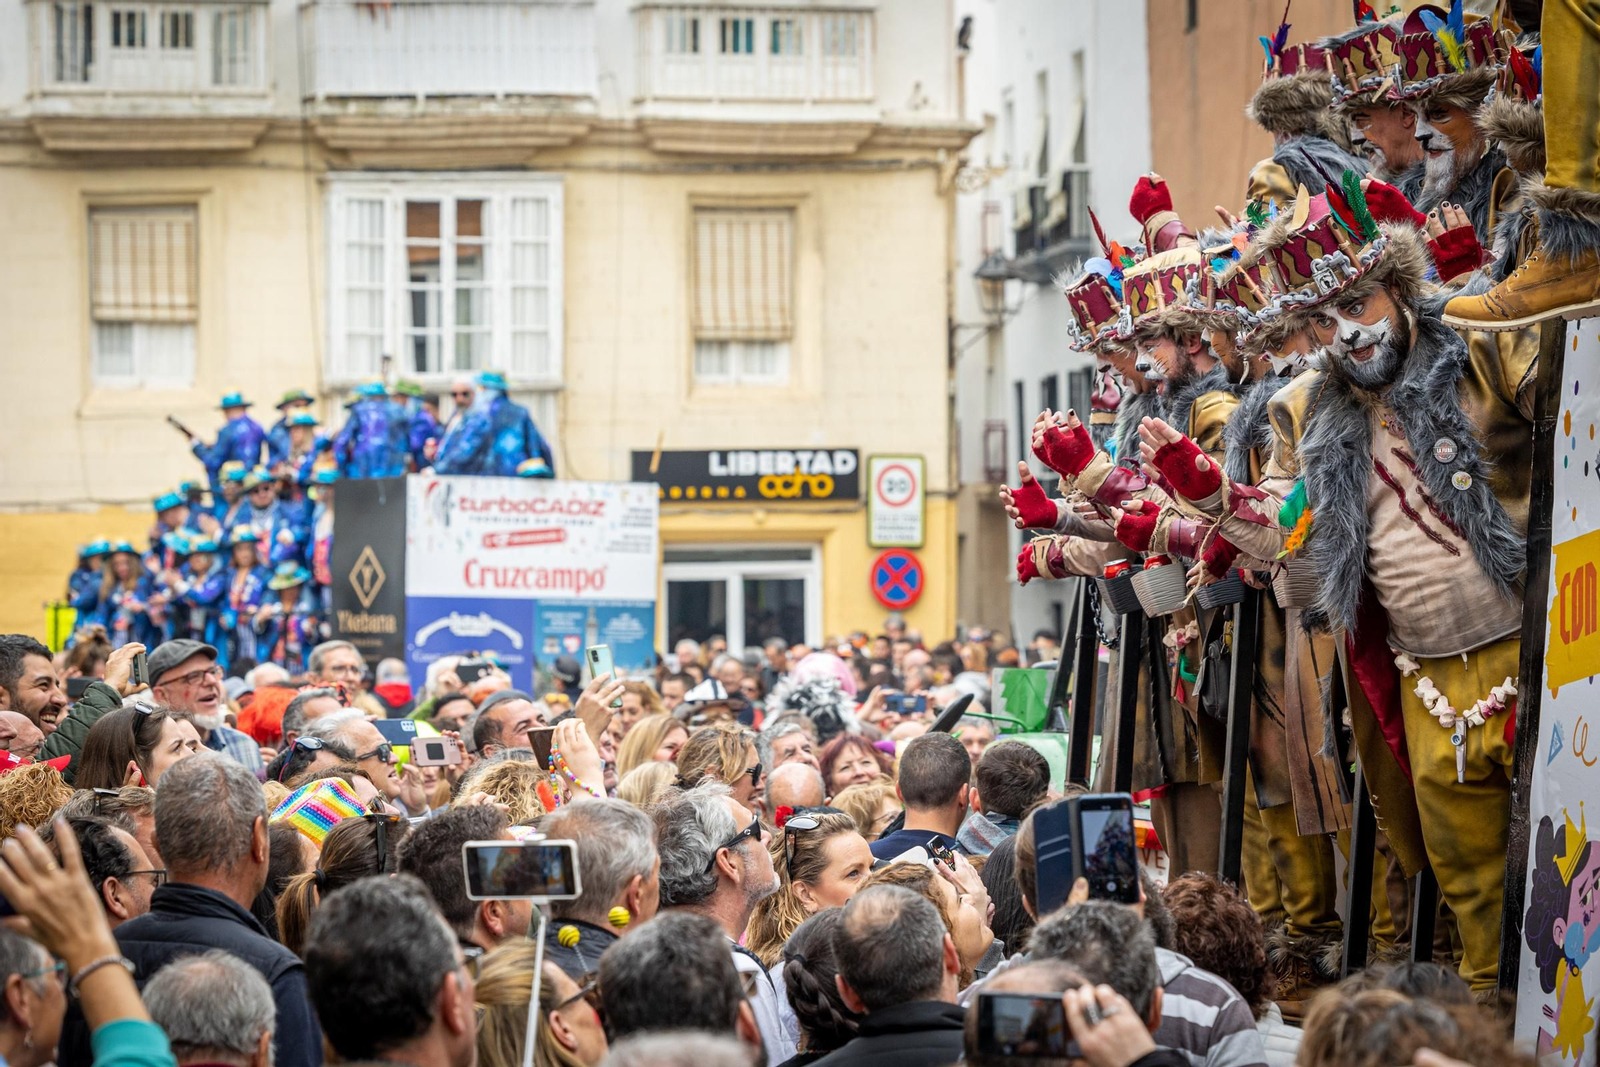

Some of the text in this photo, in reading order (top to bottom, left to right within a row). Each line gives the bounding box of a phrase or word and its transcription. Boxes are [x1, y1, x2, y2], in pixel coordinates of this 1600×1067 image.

[708, 451, 857, 476] LIBERTAD
[464, 558, 605, 597] Cruzcampo
[1559, 561, 1597, 645] CON
